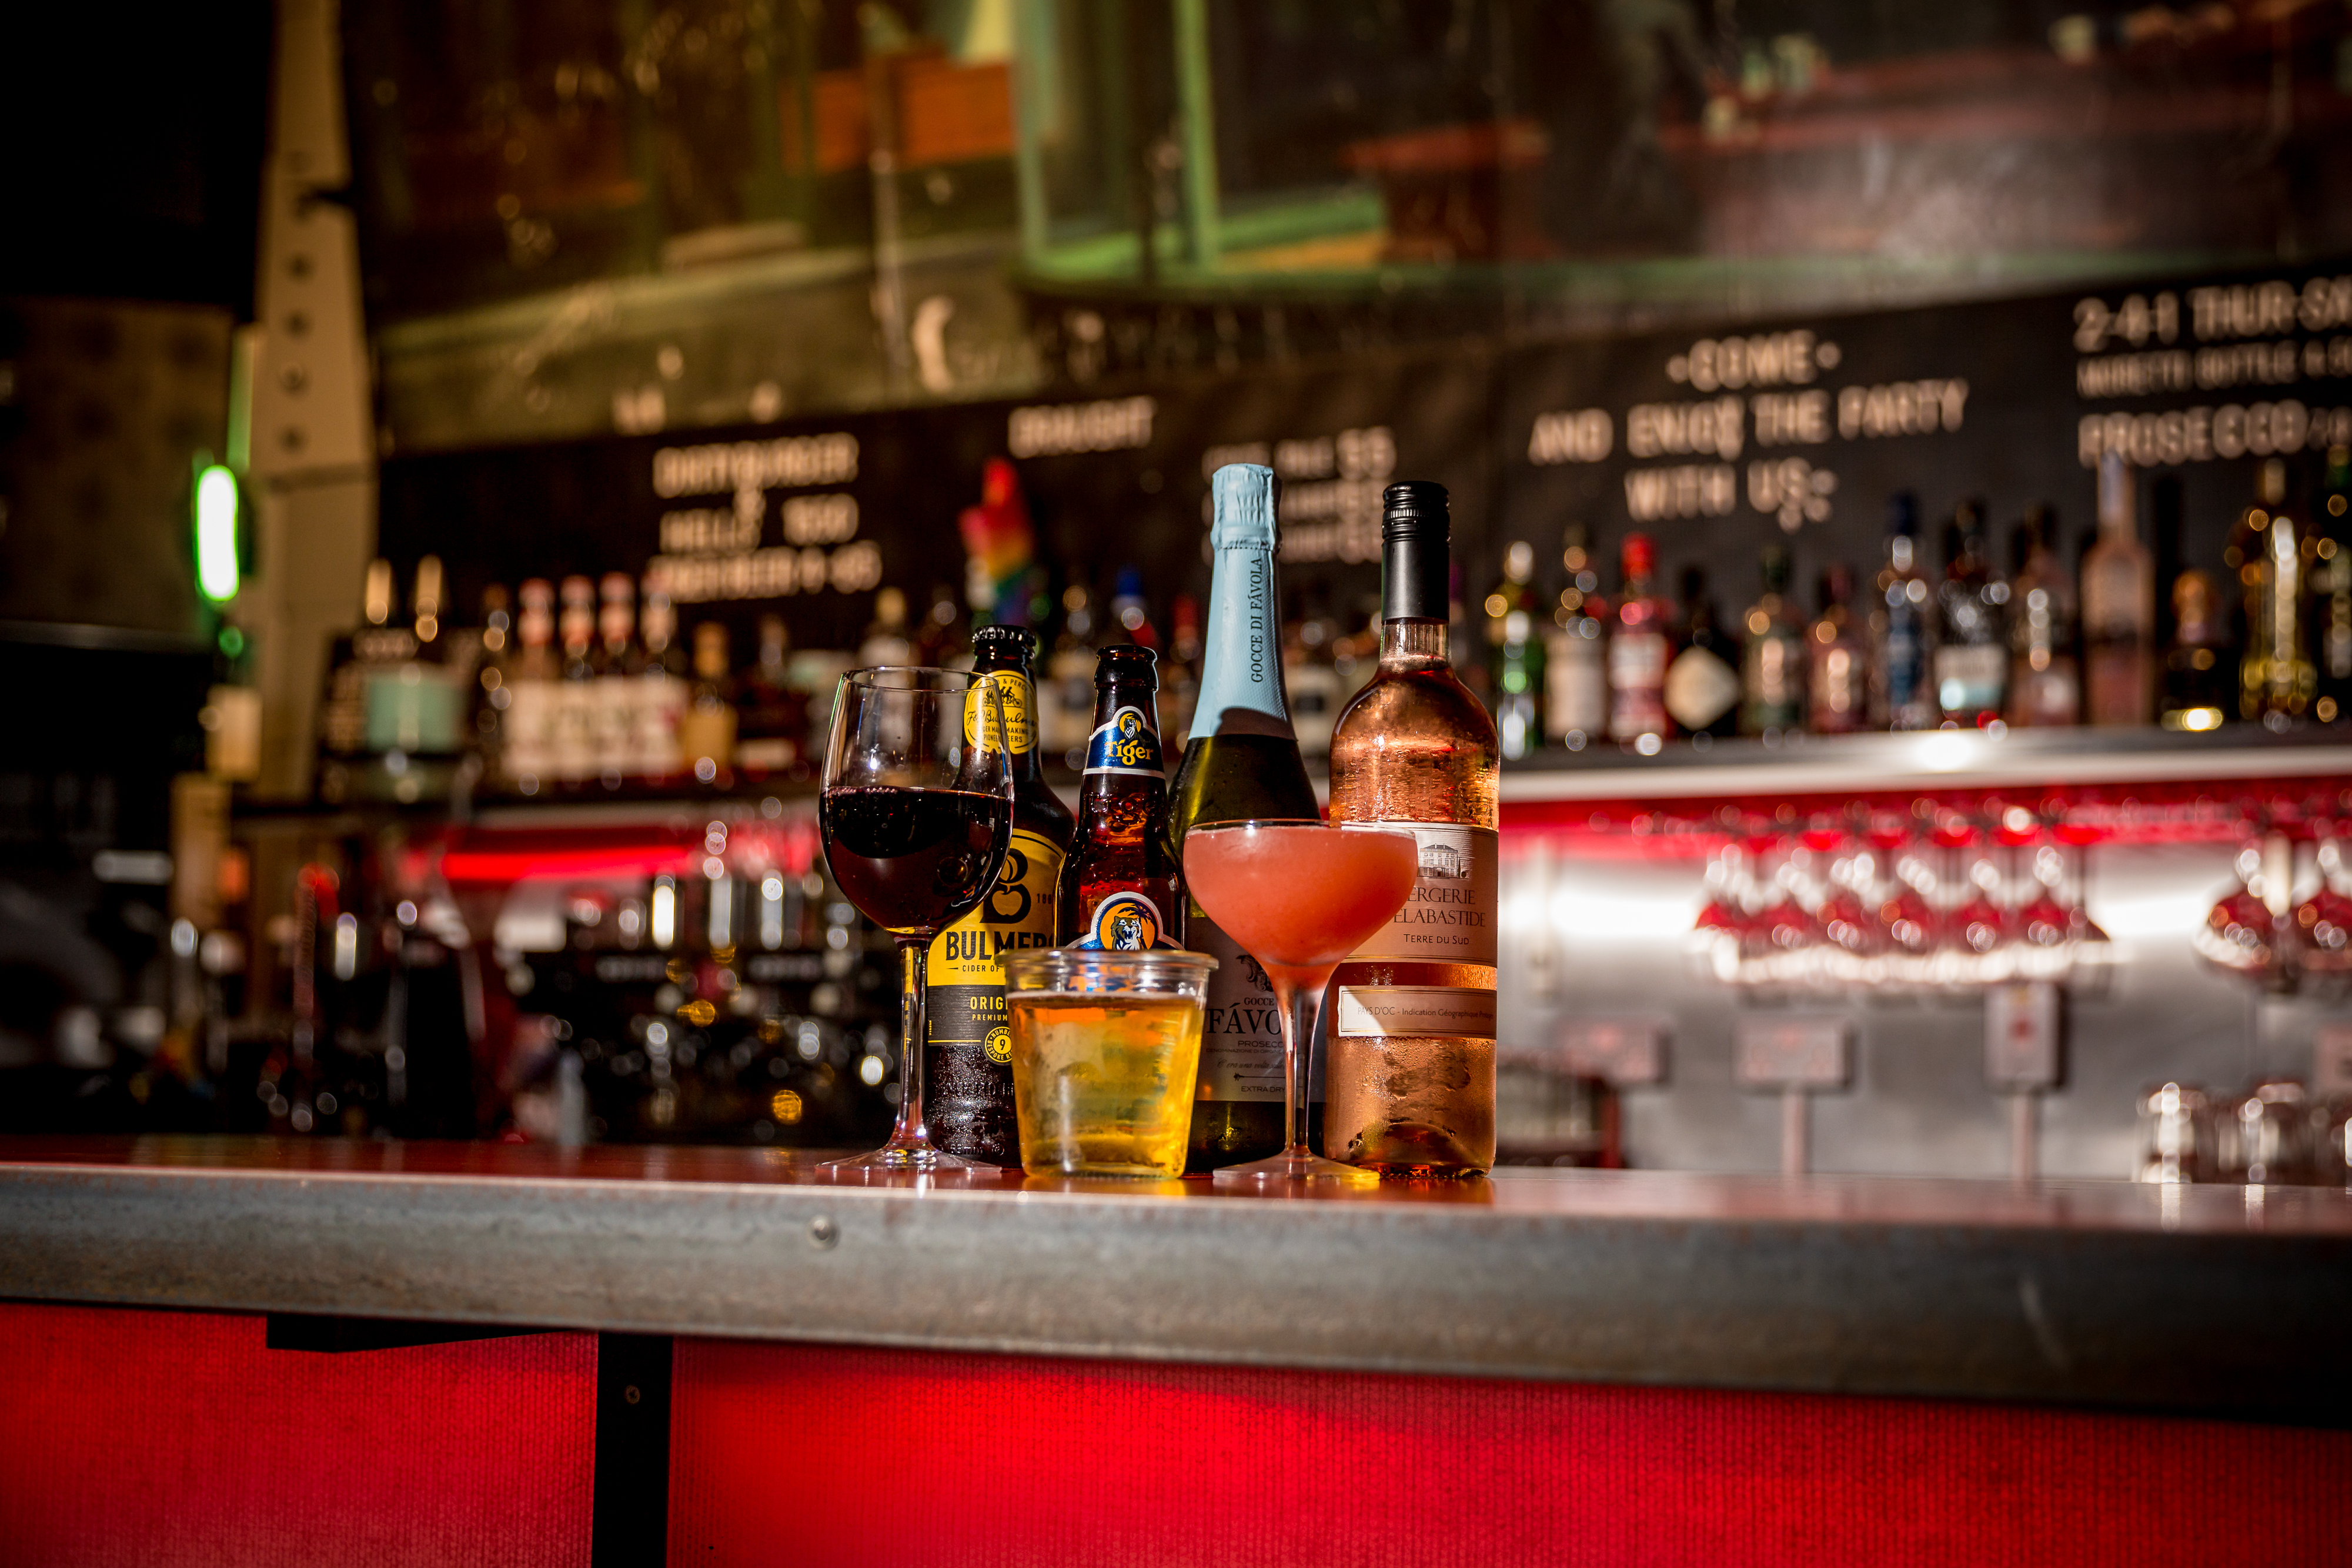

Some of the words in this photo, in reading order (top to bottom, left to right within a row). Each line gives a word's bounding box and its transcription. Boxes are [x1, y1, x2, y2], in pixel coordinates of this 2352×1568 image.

[1750, 390, 1832, 446] THE
[1838, 378, 1970, 440] PARTY
[1248, 557, 1263, 610] FÁVOLA
[1251, 615, 1262, 630] DI
[1251, 635, 1264, 683] GOCCE
[1105, 739, 1154, 765] Tiger
[1407, 887, 1475, 905] ERGERIE
[1394, 908, 1486, 927] ELABASTIDE
[946, 931, 1055, 961] BULMER
[1244, 997, 1275, 1006] GOCCE
[1207, 1002, 1282, 1035] FÁVO
[1358, 1007, 1372, 1015] PAYS
[1375, 1007, 1395, 1015] D'OC
[1438, 1009, 1478, 1019] Géographique
[991, 1029, 1011, 1038] NUMBE
[987, 1040, 1004, 1060] BESPOKE
[1000, 1039, 1005, 1050] 9
